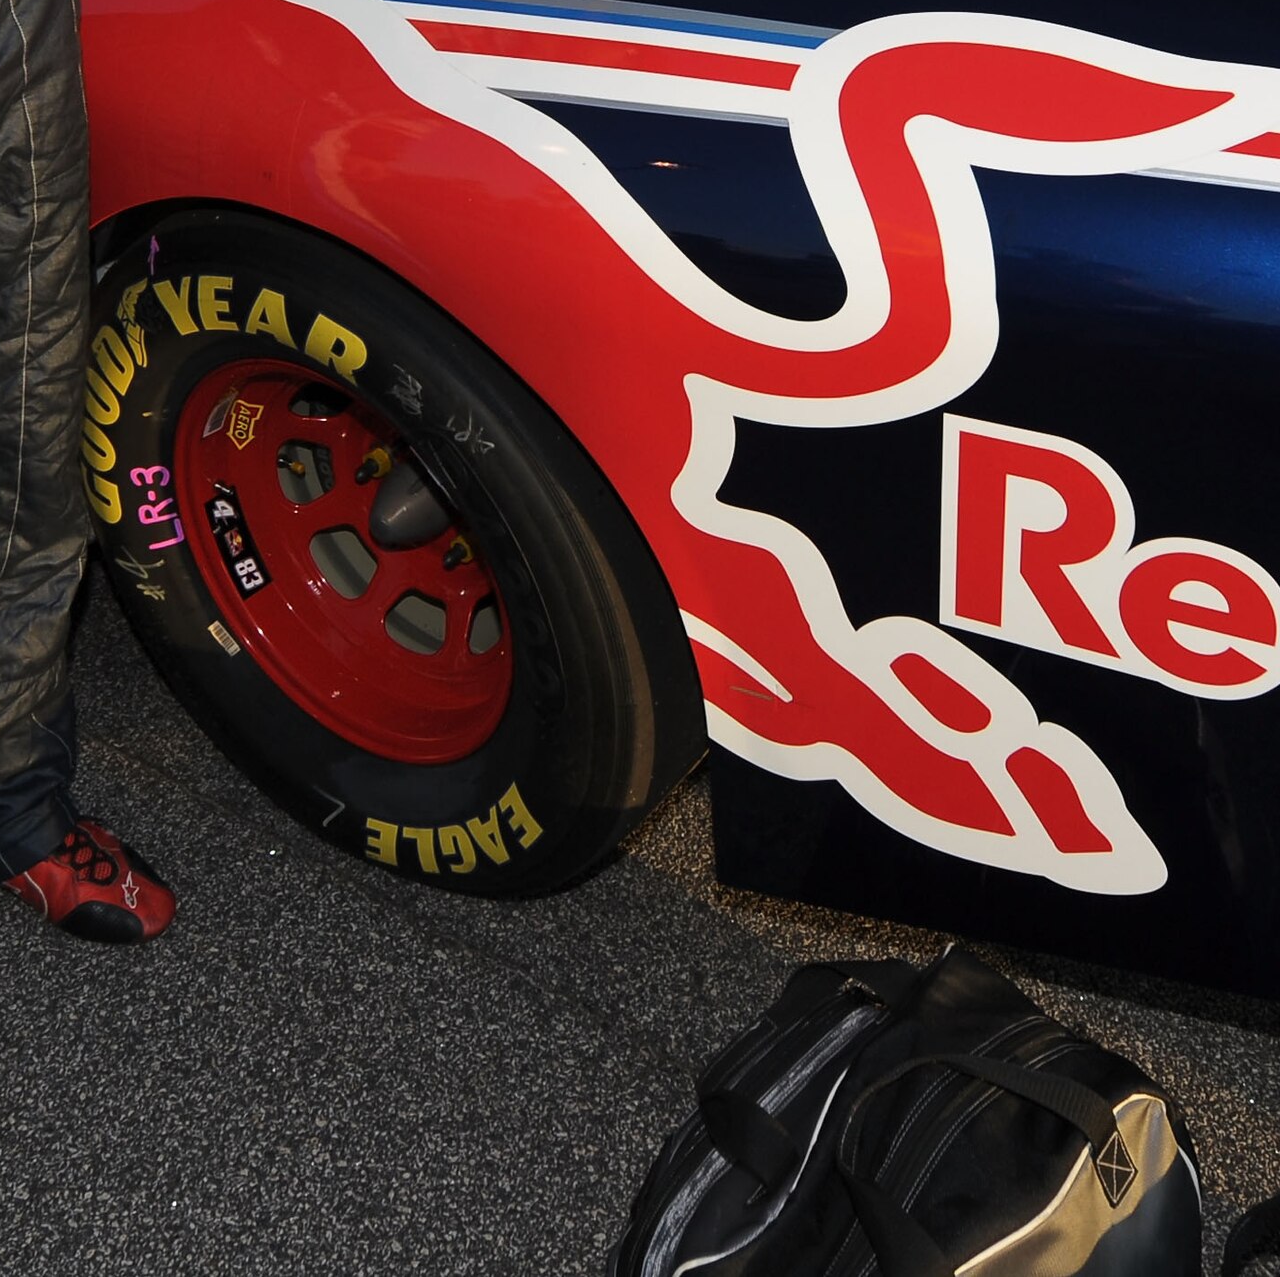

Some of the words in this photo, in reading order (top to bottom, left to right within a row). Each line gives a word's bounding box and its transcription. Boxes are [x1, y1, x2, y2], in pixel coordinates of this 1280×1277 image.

[234, 405, 251, 440] AERO
[130, 465, 186, 551] LR-3
[233, 557, 265, 591] 83
[365, 780, 544, 874] EAGLE
